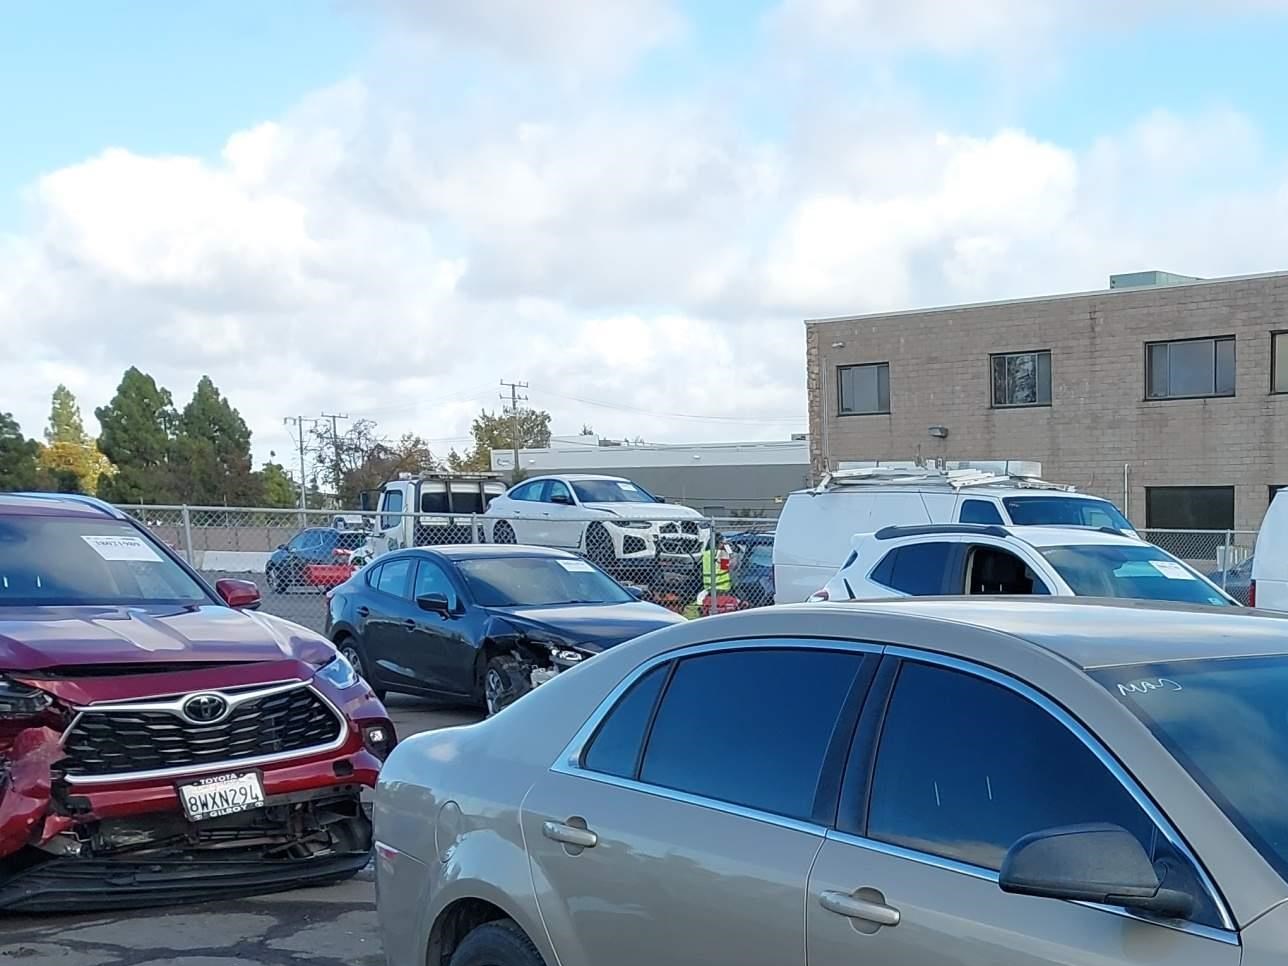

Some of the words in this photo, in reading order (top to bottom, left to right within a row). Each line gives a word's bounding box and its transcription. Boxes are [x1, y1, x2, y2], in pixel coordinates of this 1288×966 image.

[200, 773, 238, 786] TOYOTA
[188, 784, 259, 813] 8WXN294
[209, 804, 248, 818] GILROY
